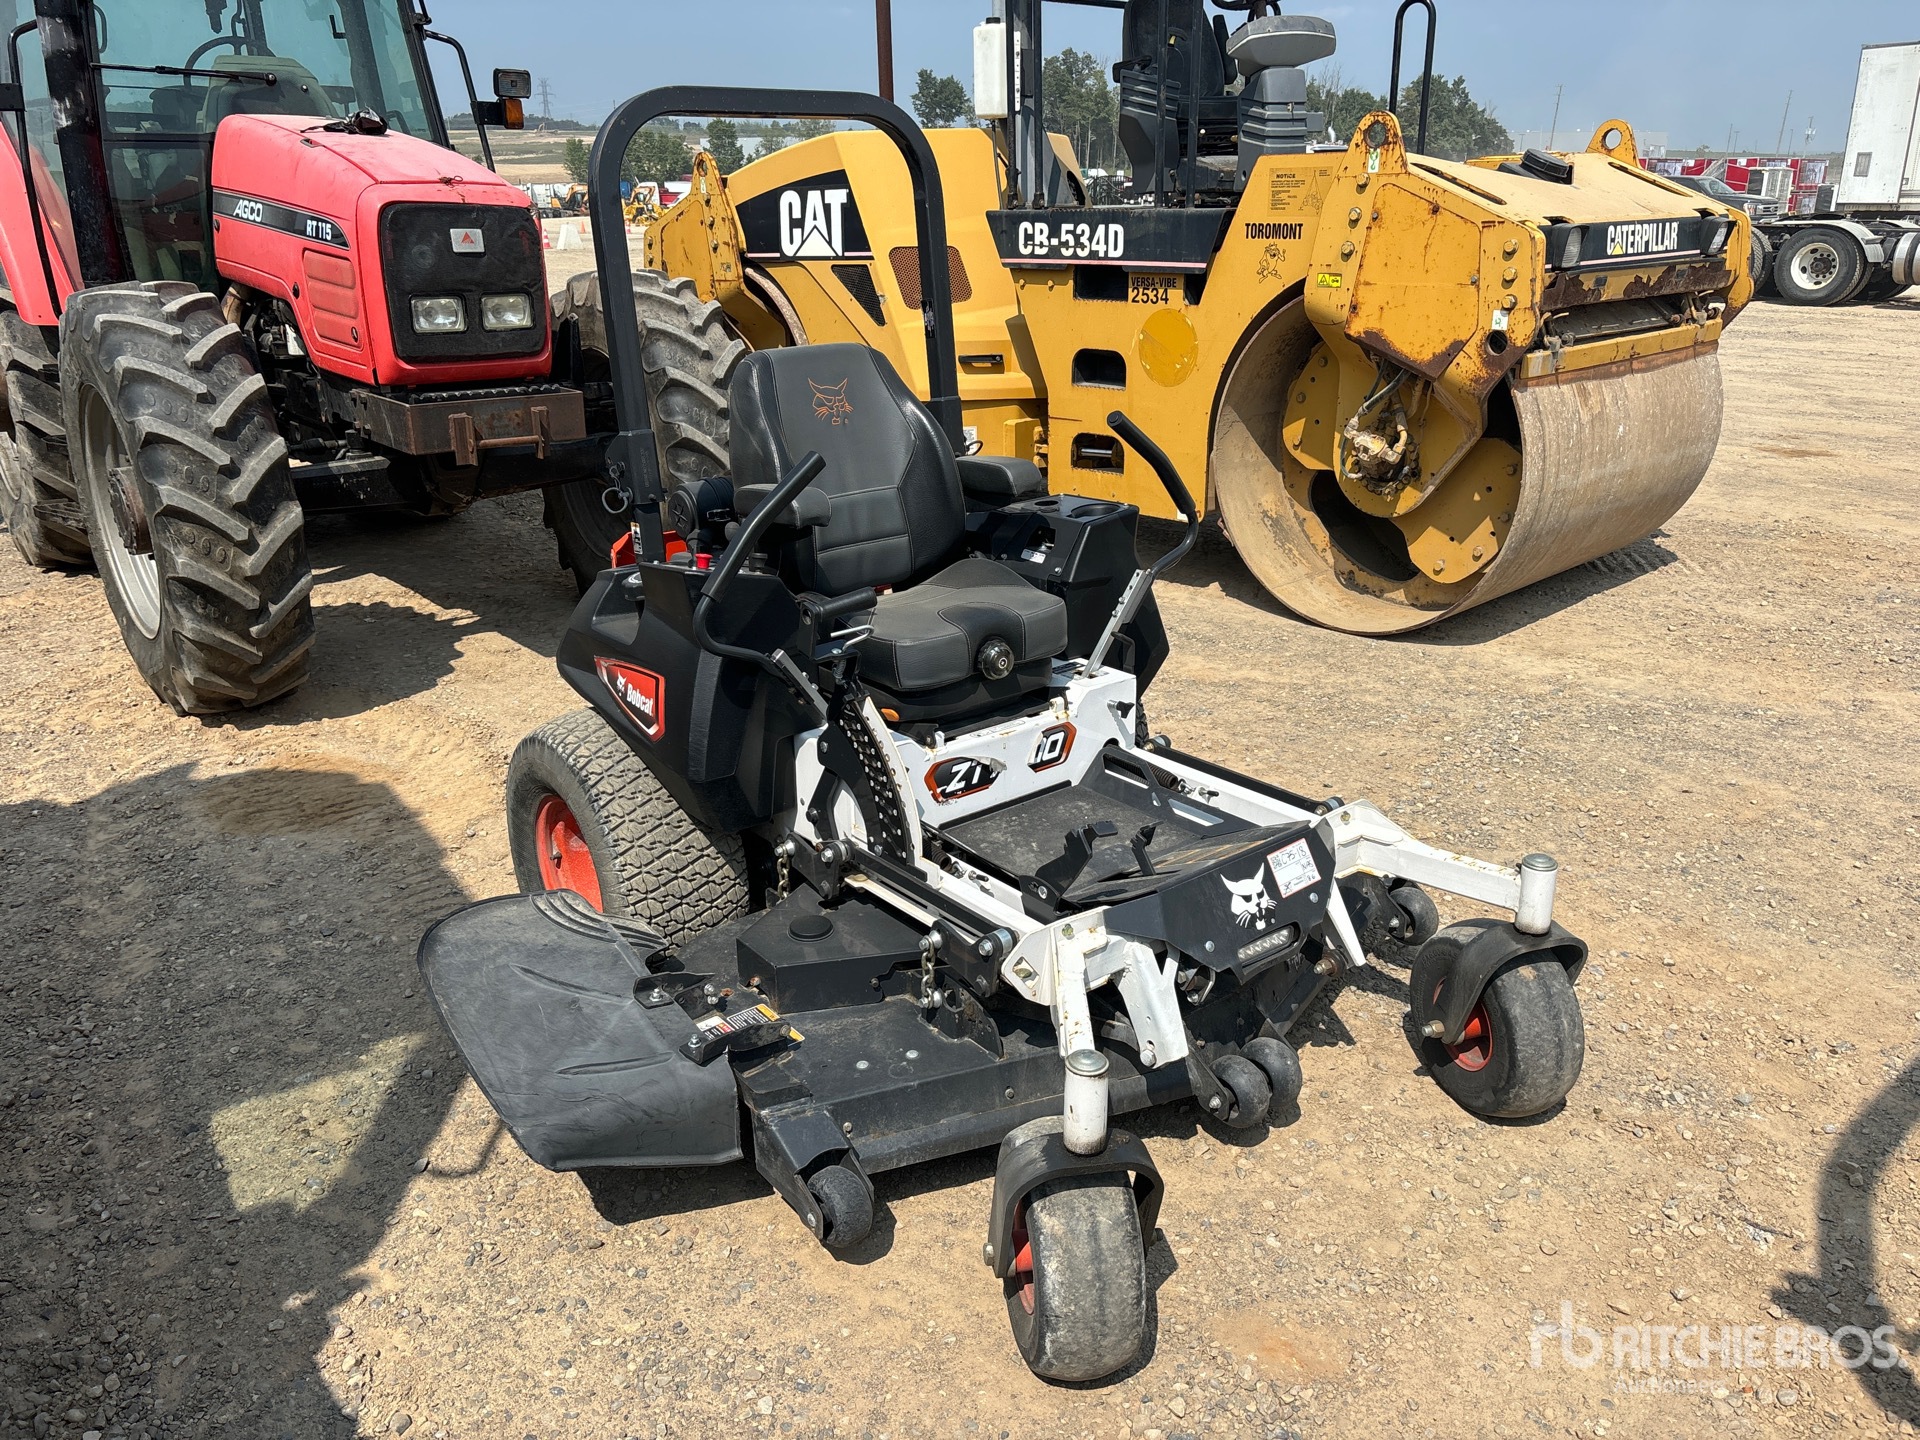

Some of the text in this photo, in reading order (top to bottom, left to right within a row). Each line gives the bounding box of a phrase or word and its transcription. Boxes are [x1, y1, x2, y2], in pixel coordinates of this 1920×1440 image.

[233, 200, 263, 222] AGCO
[306, 220, 331, 240] RT 115
[780, 189, 848, 257] CAT
[1245, 223, 1303, 239] TOROMONT
[1018, 221, 1124, 258] CB-534D
[1606, 221, 1679, 256] CATERPILLAR
[1131, 277, 1177, 288] VERSA-VIBE
[1131, 287, 1169, 304] 2534
[627, 683, 654, 717] Bobcat
